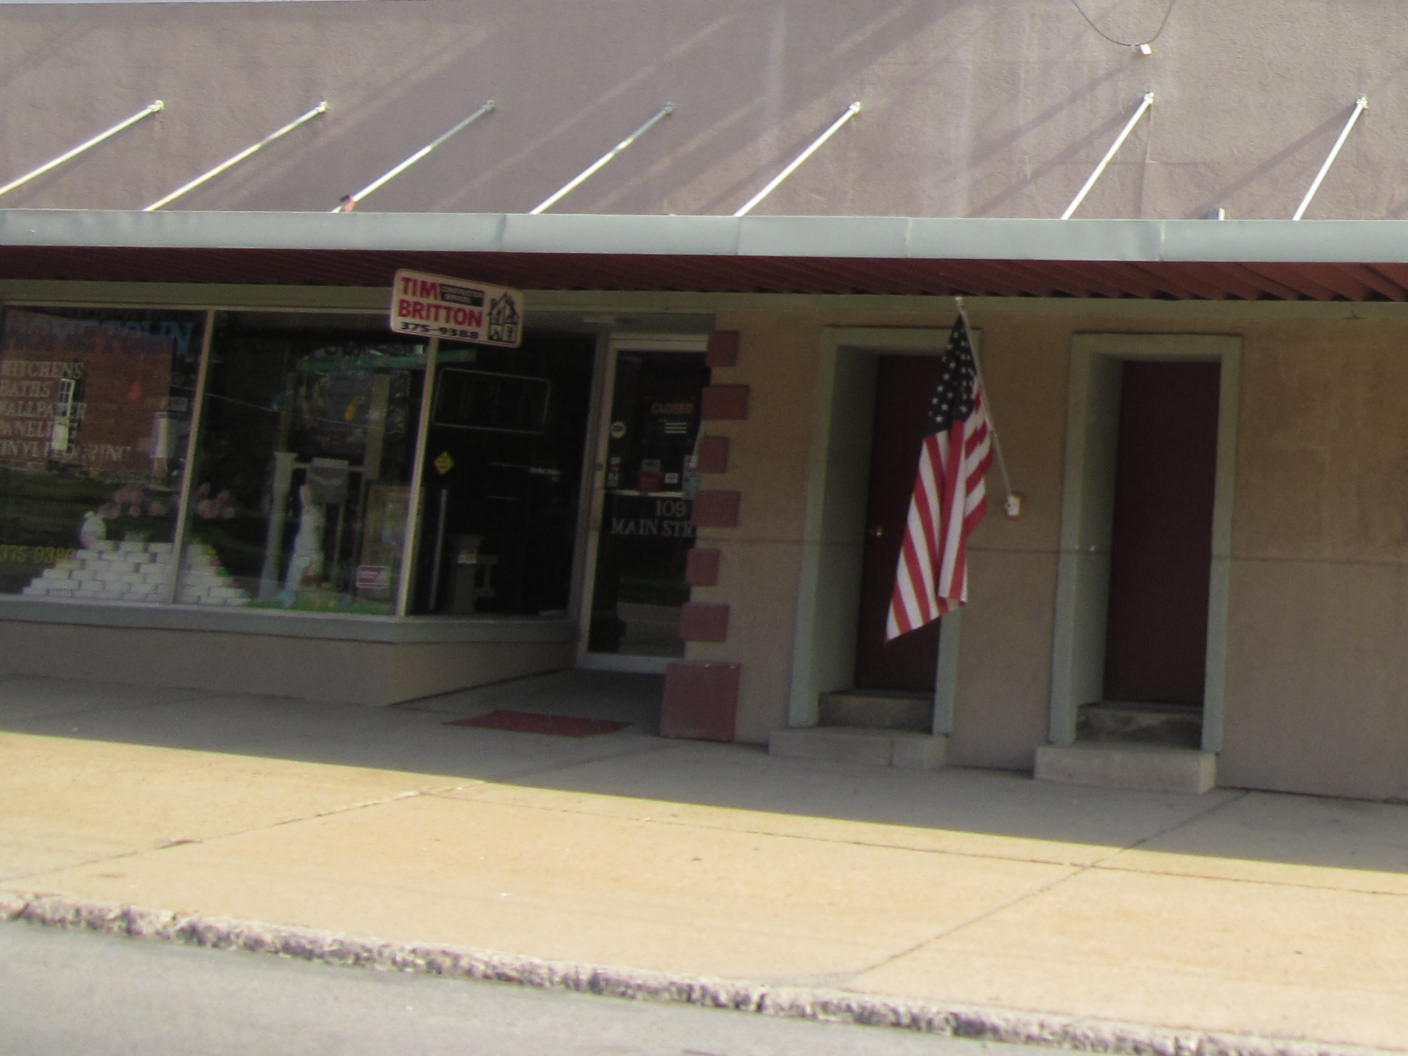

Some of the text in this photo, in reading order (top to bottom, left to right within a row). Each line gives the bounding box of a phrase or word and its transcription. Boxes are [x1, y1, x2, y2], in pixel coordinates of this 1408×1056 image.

[401, 277, 439, 301] TIM
[397, 299, 484, 329] BRITTON
[399, 321, 480, 339] 375-9388
[655, 500, 687, 518] 109
[610, 517, 661, 536] MAIN
